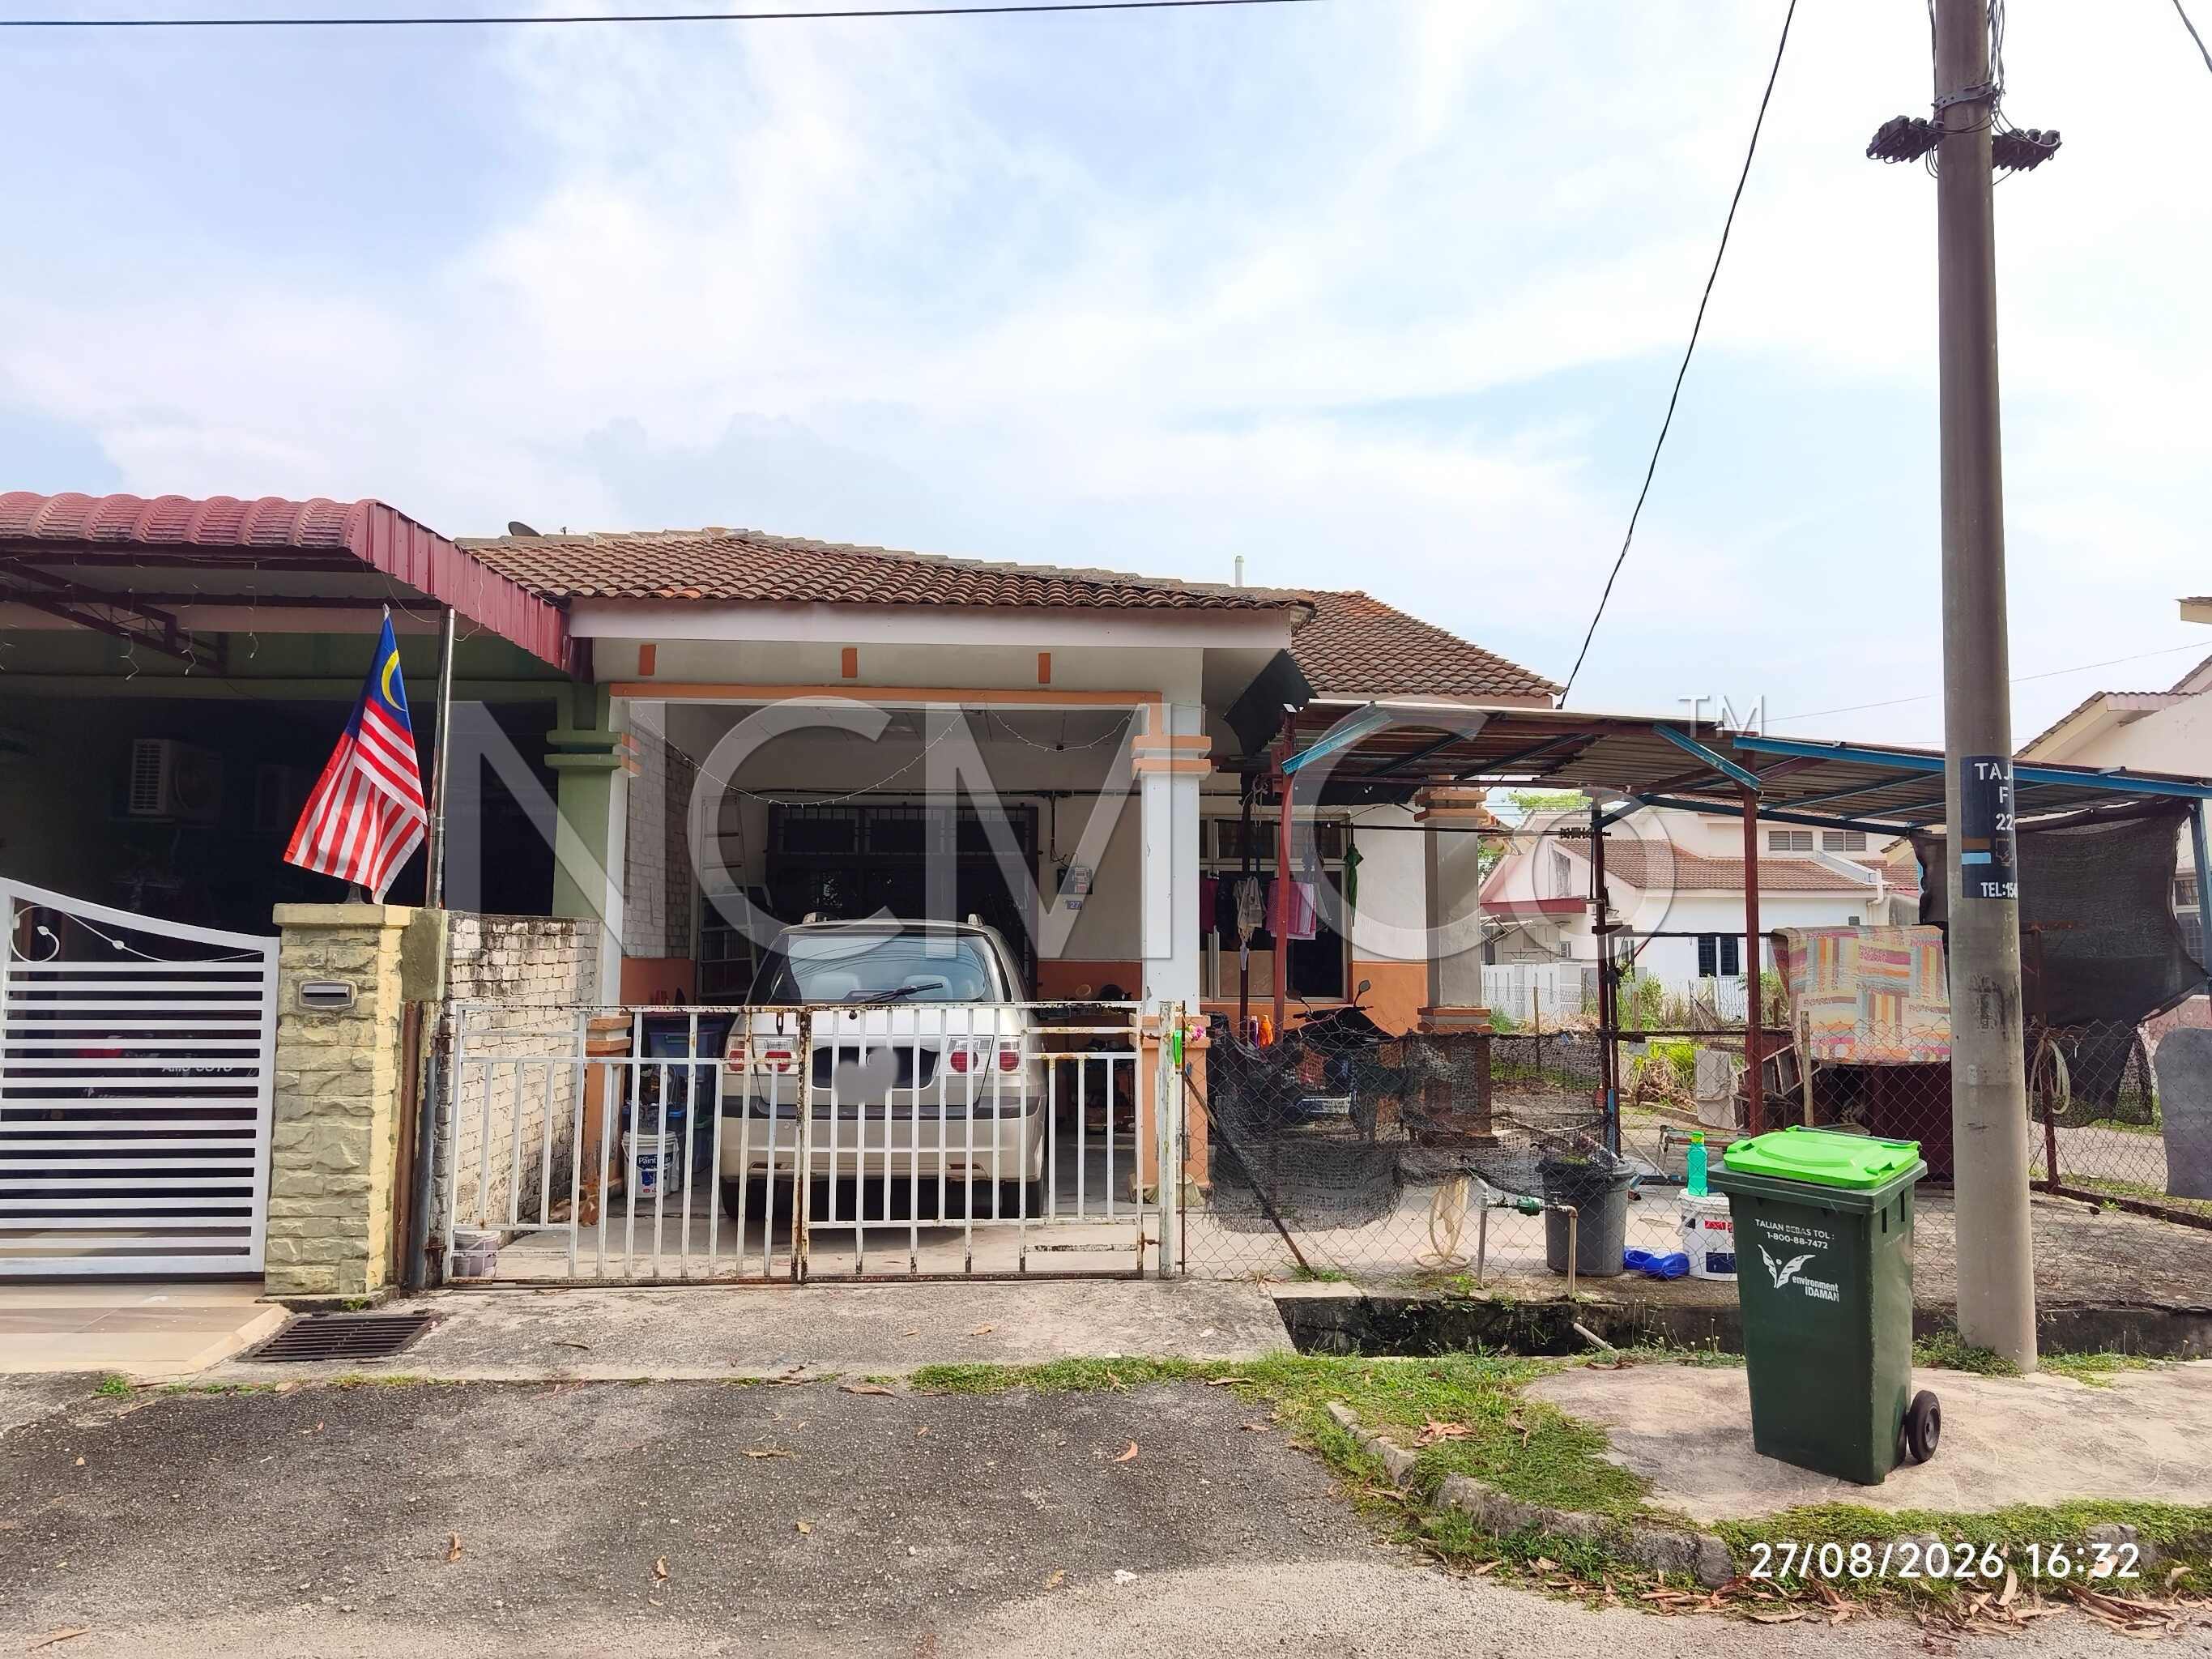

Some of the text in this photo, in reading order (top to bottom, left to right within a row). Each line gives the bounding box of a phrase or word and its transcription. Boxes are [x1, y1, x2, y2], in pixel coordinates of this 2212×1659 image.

[1754, 1218, 1784, 1231] TALIAN
[1767, 1231, 1828, 1249] 1-800-88-7472
[1792, 1276, 1839, 1292] environment
[1805, 1286, 1839, 1303] IDAMAN
